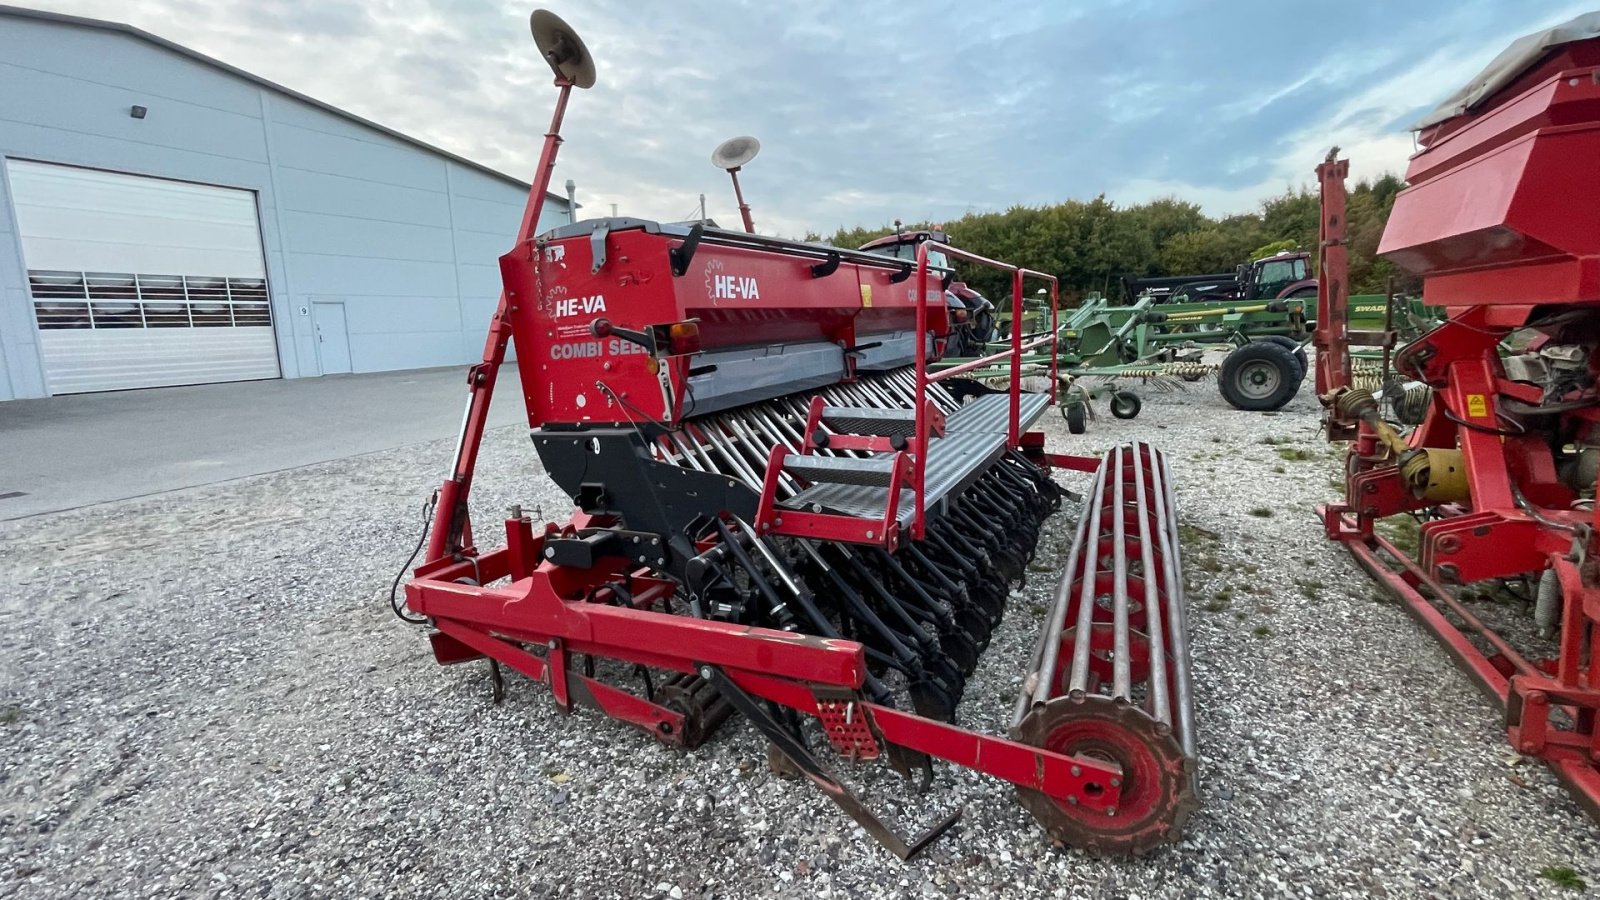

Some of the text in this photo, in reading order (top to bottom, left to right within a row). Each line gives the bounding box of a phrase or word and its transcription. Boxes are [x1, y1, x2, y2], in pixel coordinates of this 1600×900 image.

[715, 274, 760, 300] HE-VA
[301, 307, 307, 315] 9
[556, 295, 606, 317] HE-VA
[550, 341, 603, 360] COMBI
